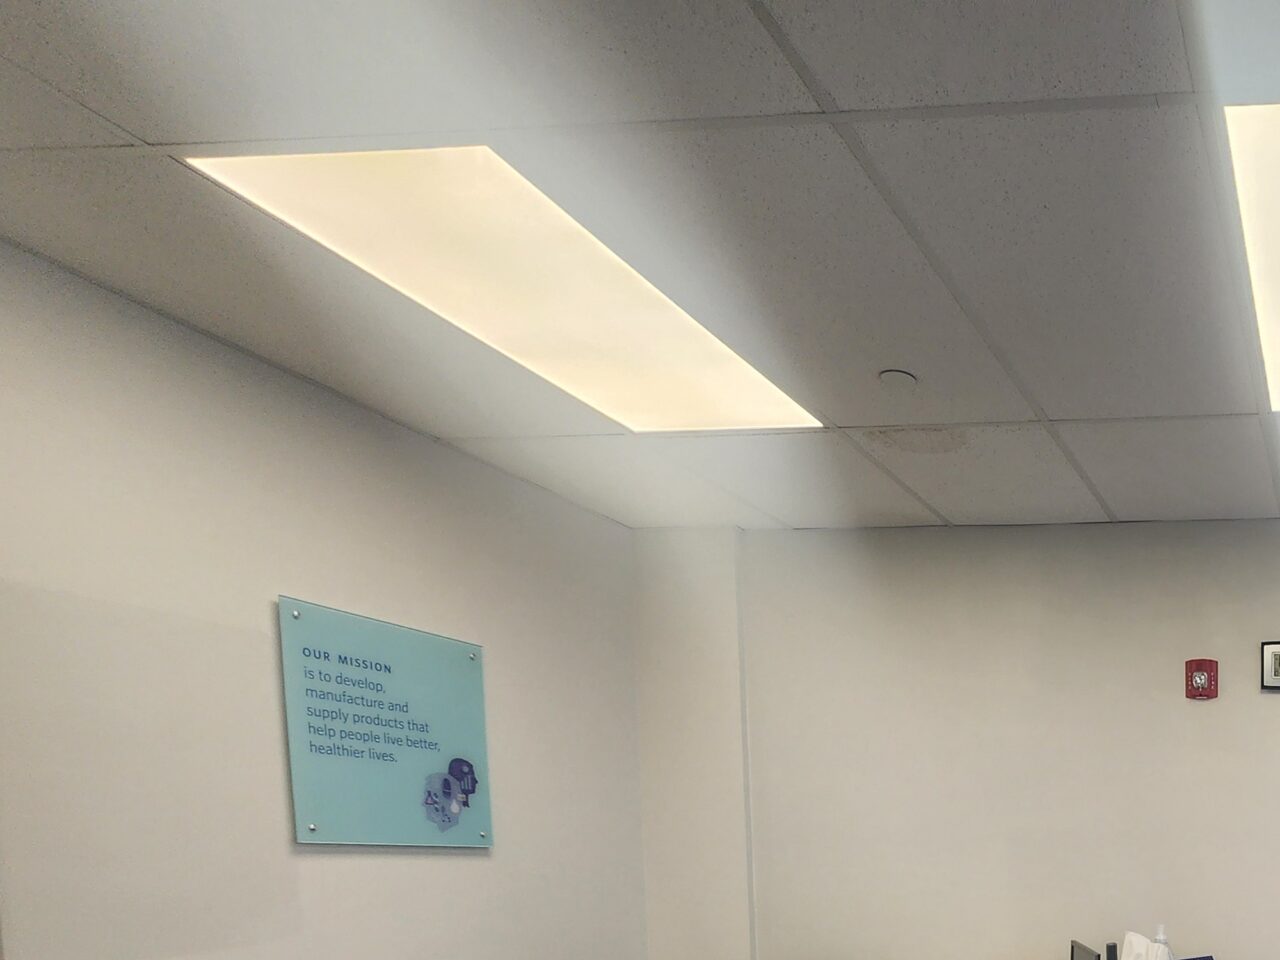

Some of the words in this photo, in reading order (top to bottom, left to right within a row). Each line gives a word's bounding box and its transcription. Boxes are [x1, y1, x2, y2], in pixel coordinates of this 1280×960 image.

[302, 647, 331, 661] OUR
[338, 654, 392, 673] MISSION
[304, 666, 315, 680] is
[319, 670, 332, 683] to
[335, 672, 386, 694] develop,
[305, 687, 385, 710] manufacture
[388, 701, 409, 713] and
[306, 706, 349, 724] supply
[352, 713, 405, 730] products
[407, 719, 429, 733] that
[308, 721, 336, 739] help
[340, 729, 381, 744] people
[383, 732, 403, 746] live
[406, 735, 441, 752] better,
[309, 740, 366, 759] healthier
[368, 748, 398, 763] lives.
